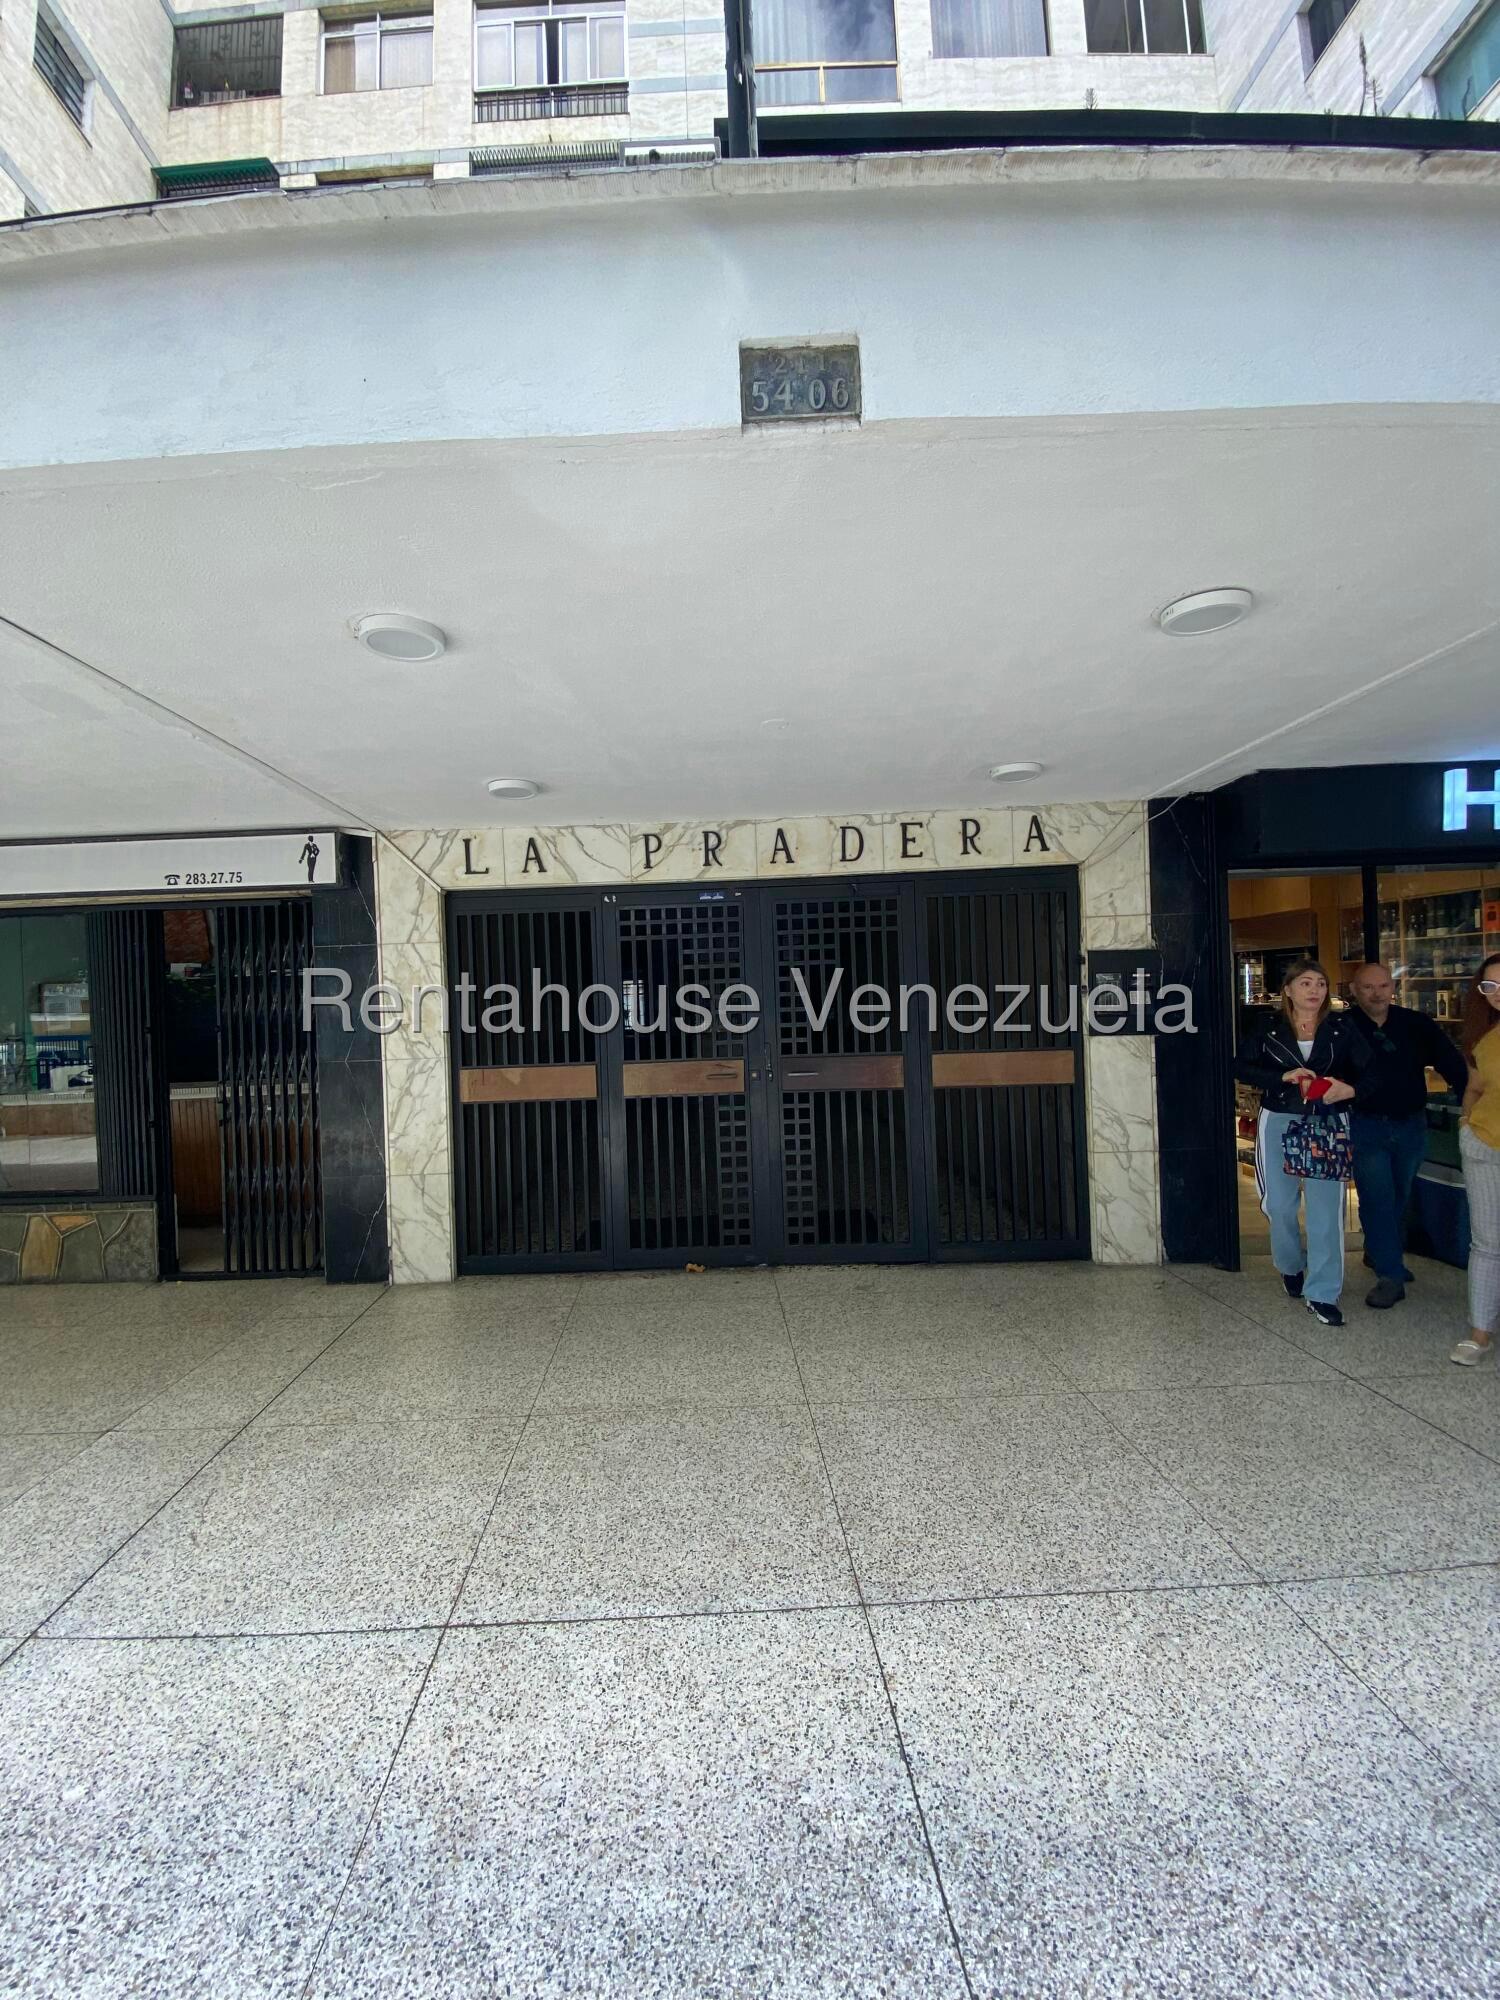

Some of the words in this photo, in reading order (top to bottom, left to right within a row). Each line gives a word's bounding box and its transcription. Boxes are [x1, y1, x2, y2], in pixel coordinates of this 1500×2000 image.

[462, 837, 547, 875] LA
[643, 815, 1050, 869] PRADERA
[185, 871, 243, 885] 283.27.75
